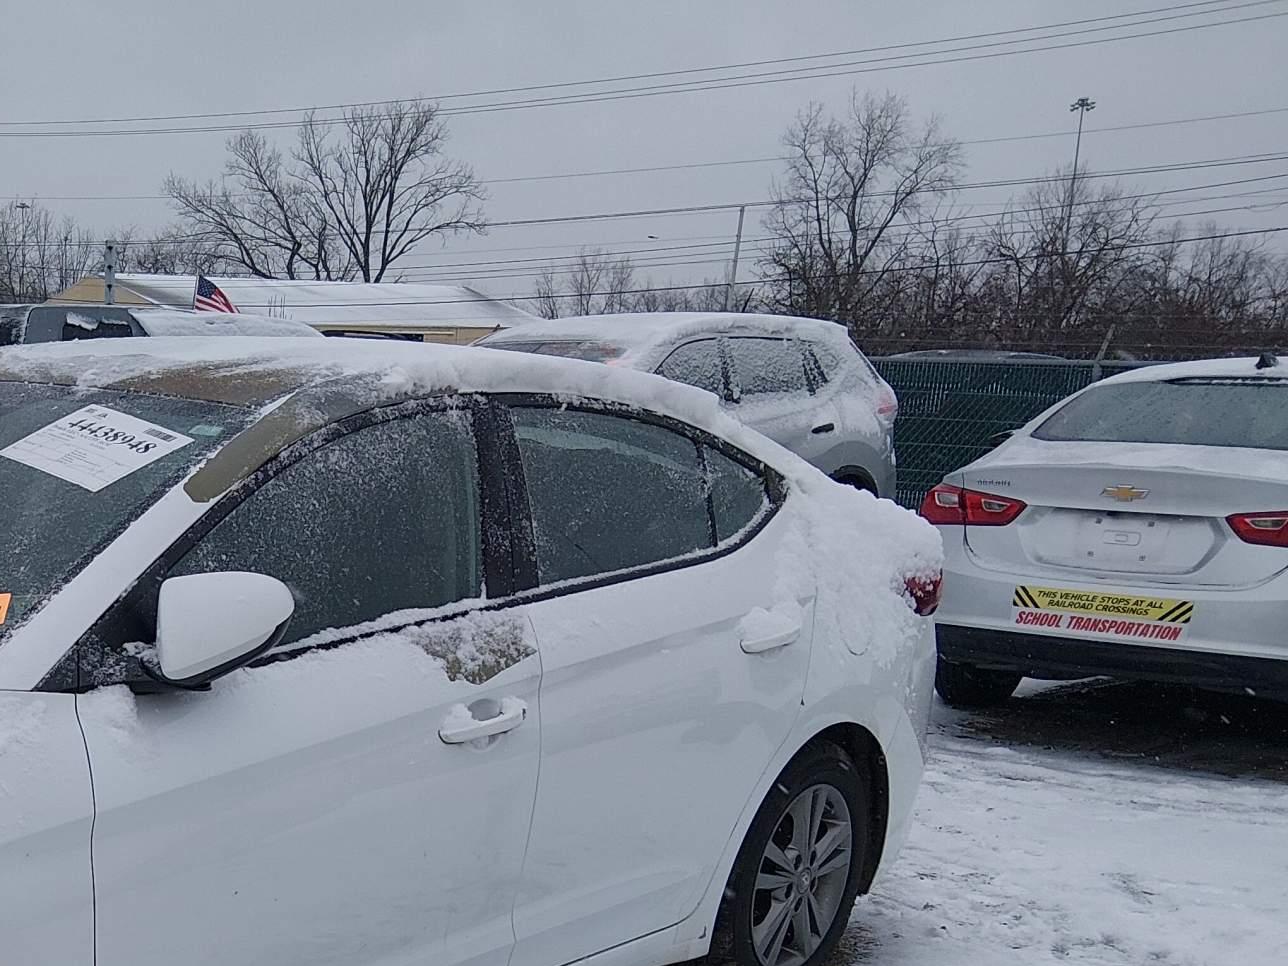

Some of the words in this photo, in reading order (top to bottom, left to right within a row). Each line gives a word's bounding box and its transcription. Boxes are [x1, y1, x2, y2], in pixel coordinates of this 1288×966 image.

[68, 418, 158, 454] 44438948
[1037, 590, 1058, 599] THIS
[1059, 592, 1097, 602] VEHICLE
[1100, 596, 1131, 606] STOPS
[1132, 599, 1145, 608] AT
[1146, 601, 1163, 609] ALL
[1047, 599, 1093, 610] RAILROAD
[1095, 604, 1150, 616] CROSSINGS
[1015, 610, 1064, 628] SCHOOL
[1066, 615, 1183, 641] TRANSPORTATION
